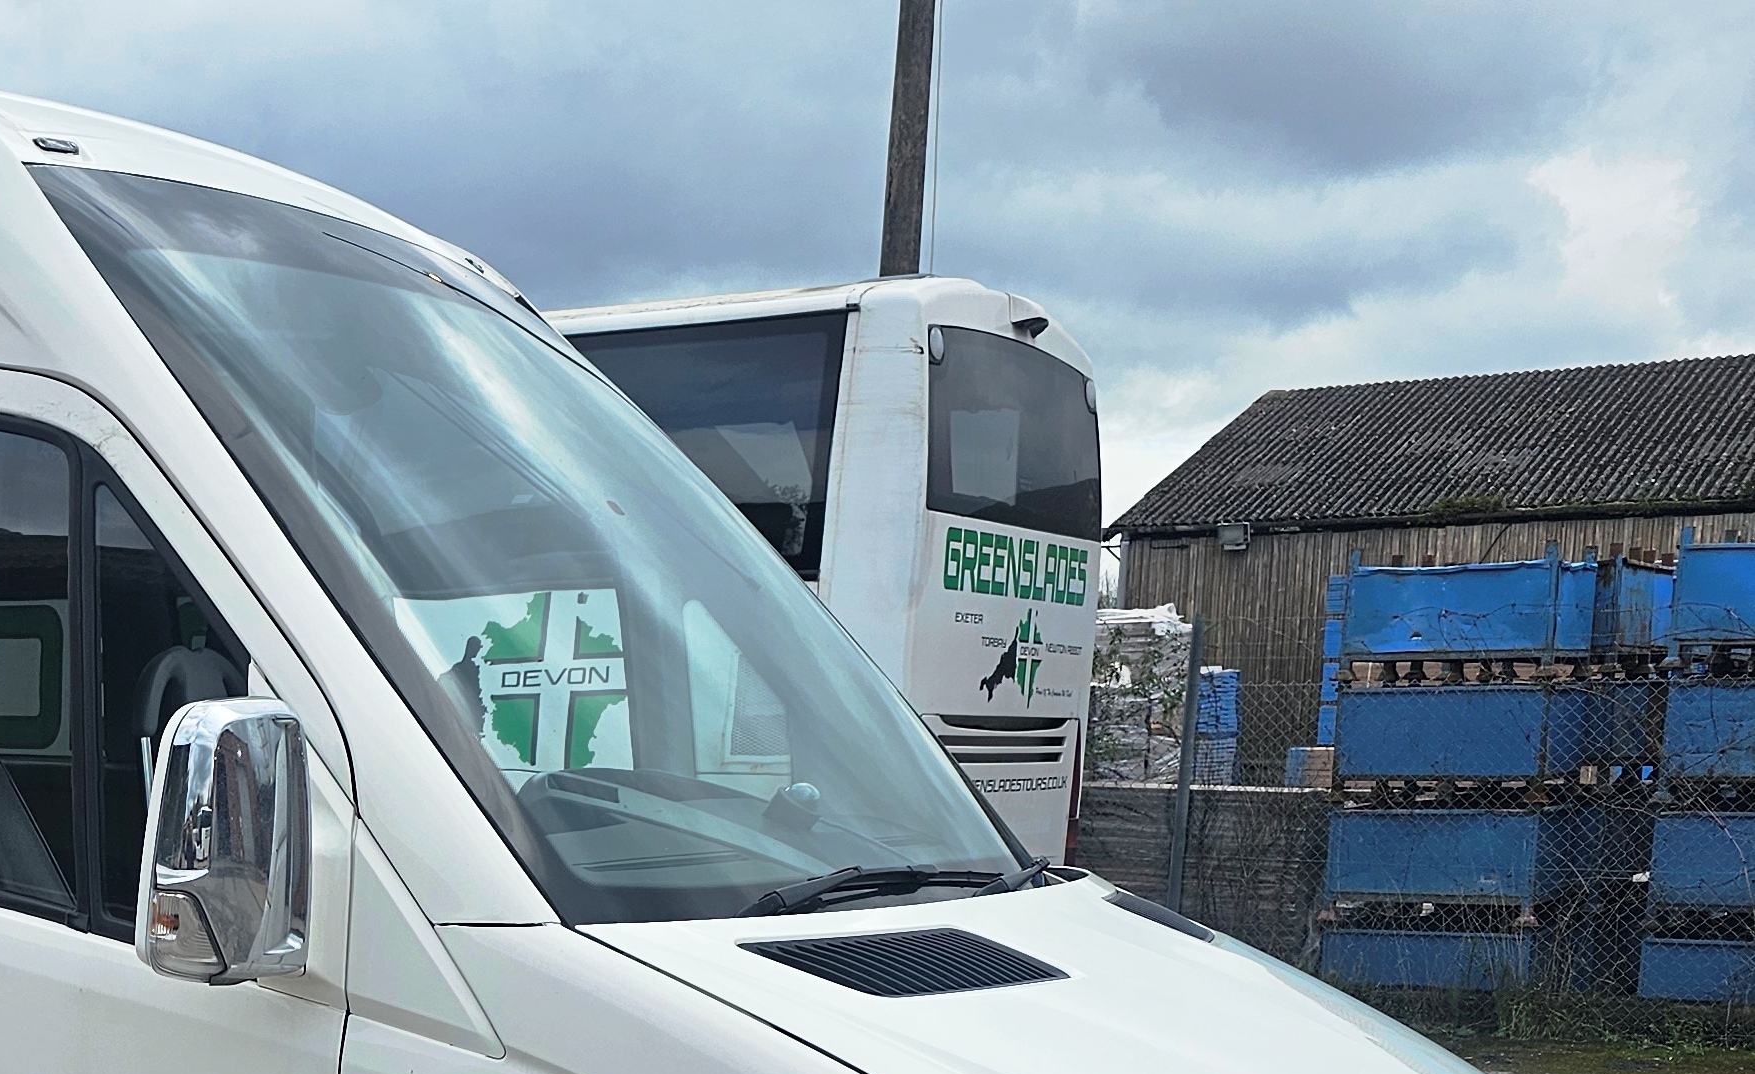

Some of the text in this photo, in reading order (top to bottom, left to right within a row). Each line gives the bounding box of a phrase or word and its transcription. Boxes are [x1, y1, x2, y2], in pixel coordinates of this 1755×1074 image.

[943, 526, 1089, 606] GREENSLADES
[955, 612, 983, 624] EXETER
[1019, 645, 1040, 657] DEVON
[500, 665, 611, 689] DEVON
